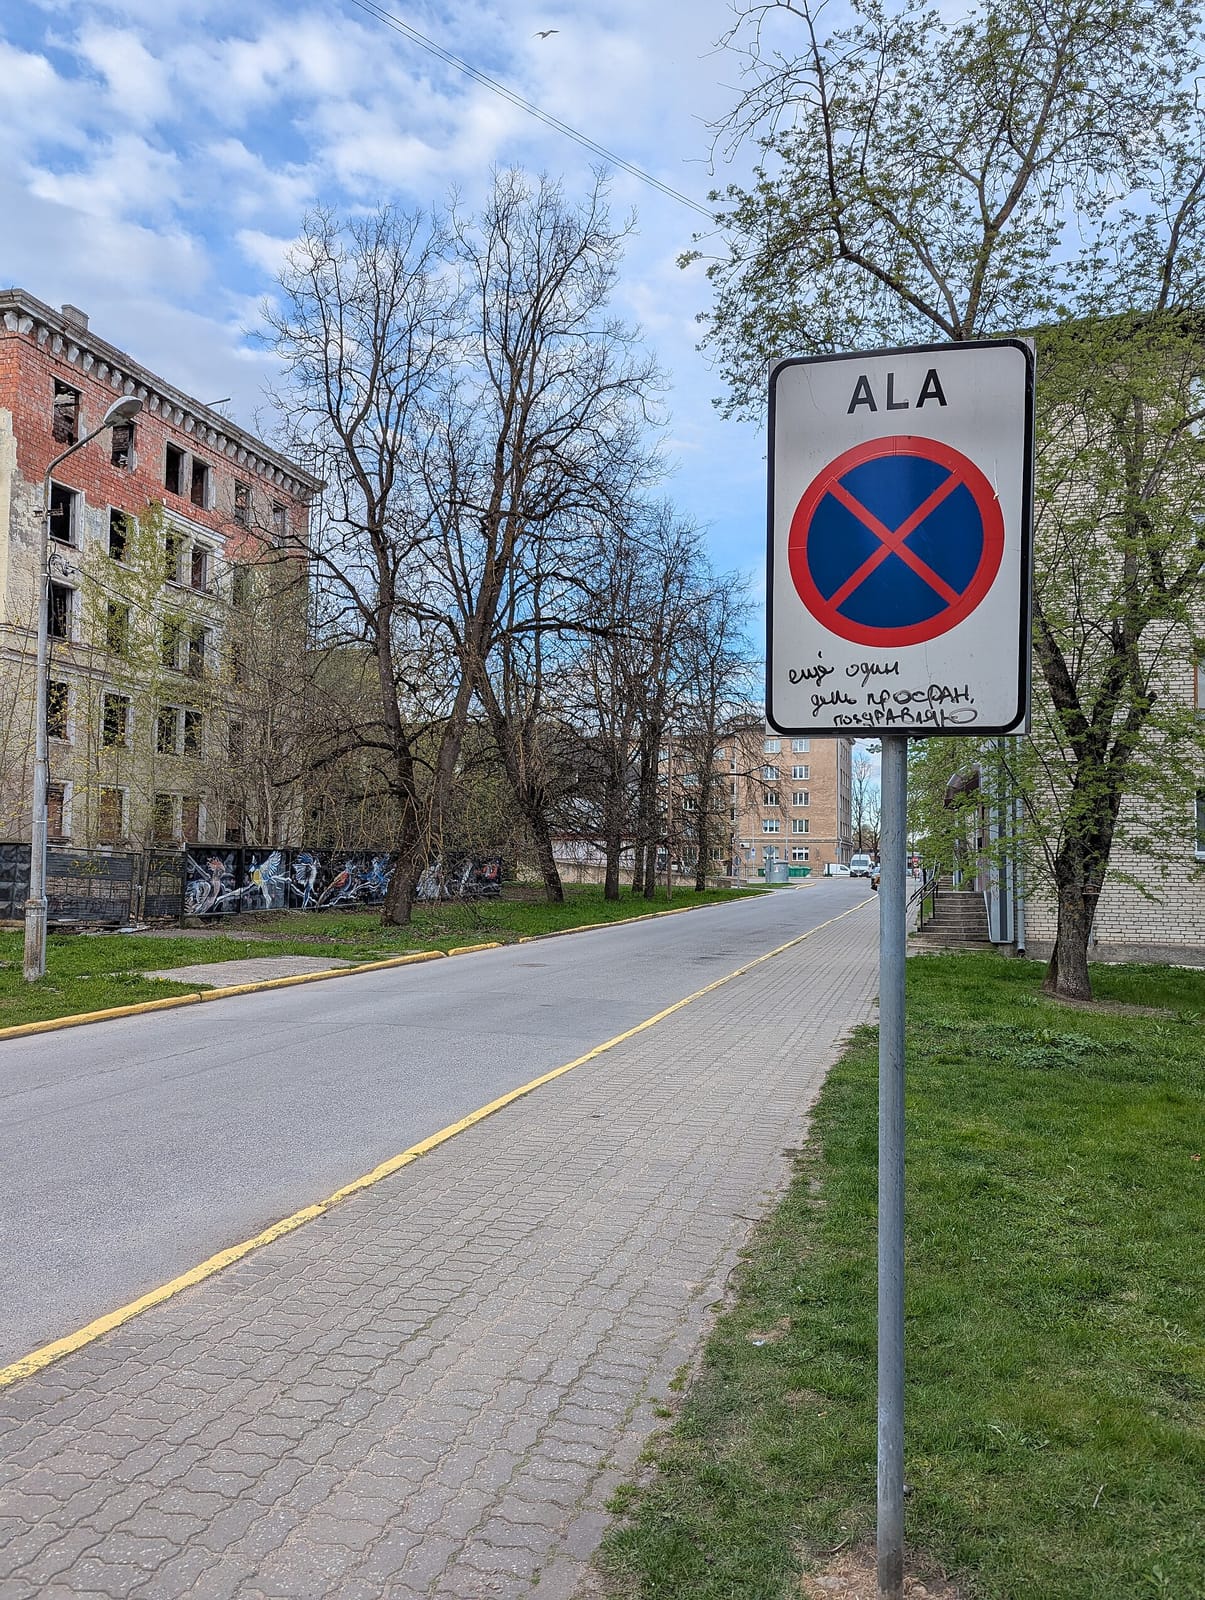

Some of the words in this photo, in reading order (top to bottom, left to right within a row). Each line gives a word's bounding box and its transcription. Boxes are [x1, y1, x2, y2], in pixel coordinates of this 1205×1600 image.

[847, 368, 948, 414] ALA
[845, 660, 900, 688] один
[810, 689, 857, 717] день
